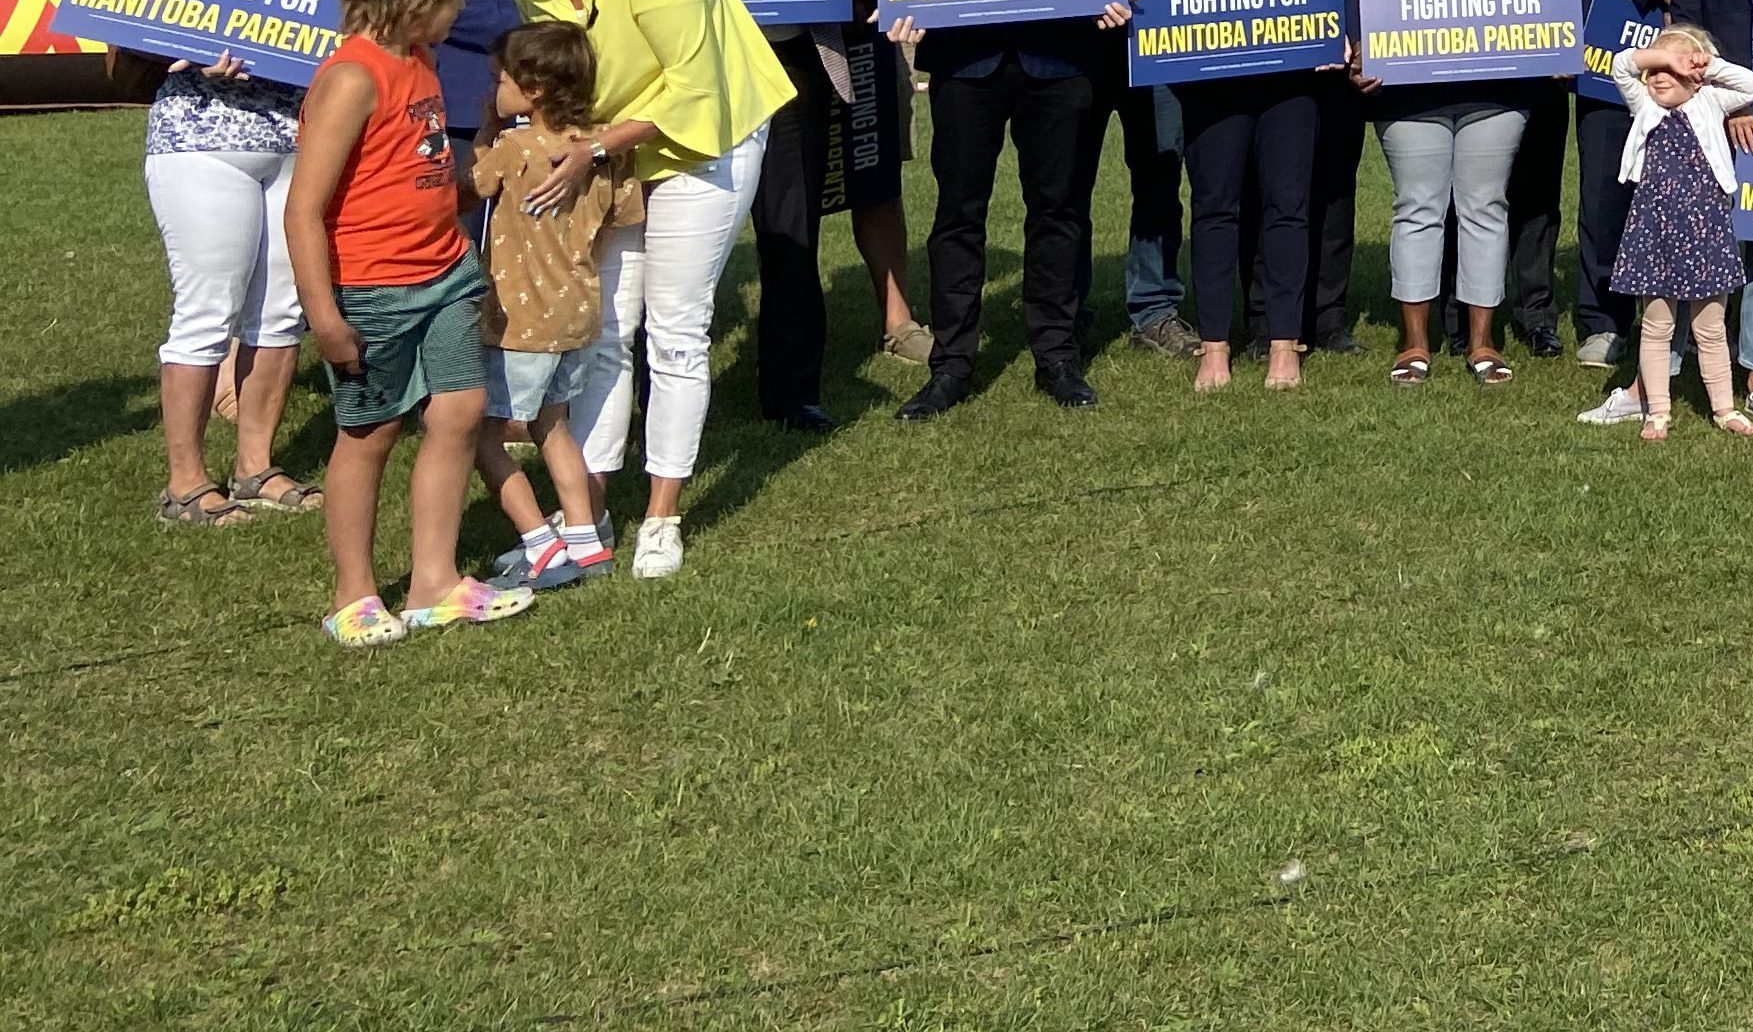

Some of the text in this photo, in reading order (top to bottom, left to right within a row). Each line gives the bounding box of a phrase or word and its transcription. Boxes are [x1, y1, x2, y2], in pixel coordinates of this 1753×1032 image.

[1138, 12, 1340, 56] MANITOBA PARENTS
[1369, 22, 1576, 59] MANITOBA PARENTS
[847, 42, 880, 171] FIGHTING FOR
